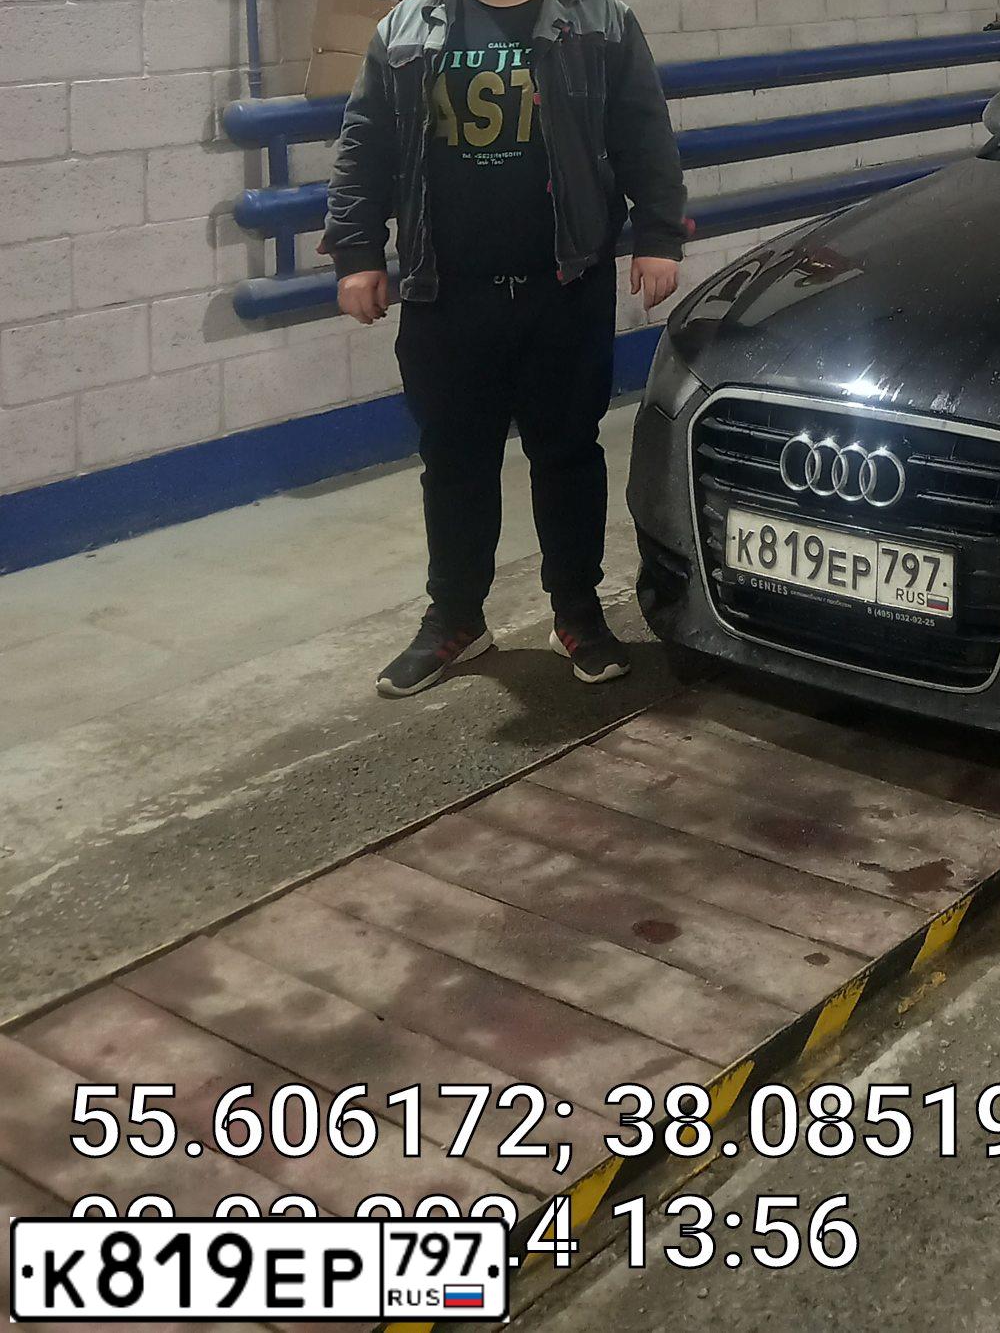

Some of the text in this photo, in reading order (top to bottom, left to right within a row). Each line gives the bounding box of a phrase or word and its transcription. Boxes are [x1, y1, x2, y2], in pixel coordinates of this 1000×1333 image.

[736, 524, 872, 591] К819ЕР
[881, 547, 941, 592] 797
[750, 577, 789, 596] GENZES
[895, 587, 926, 605] RUS
